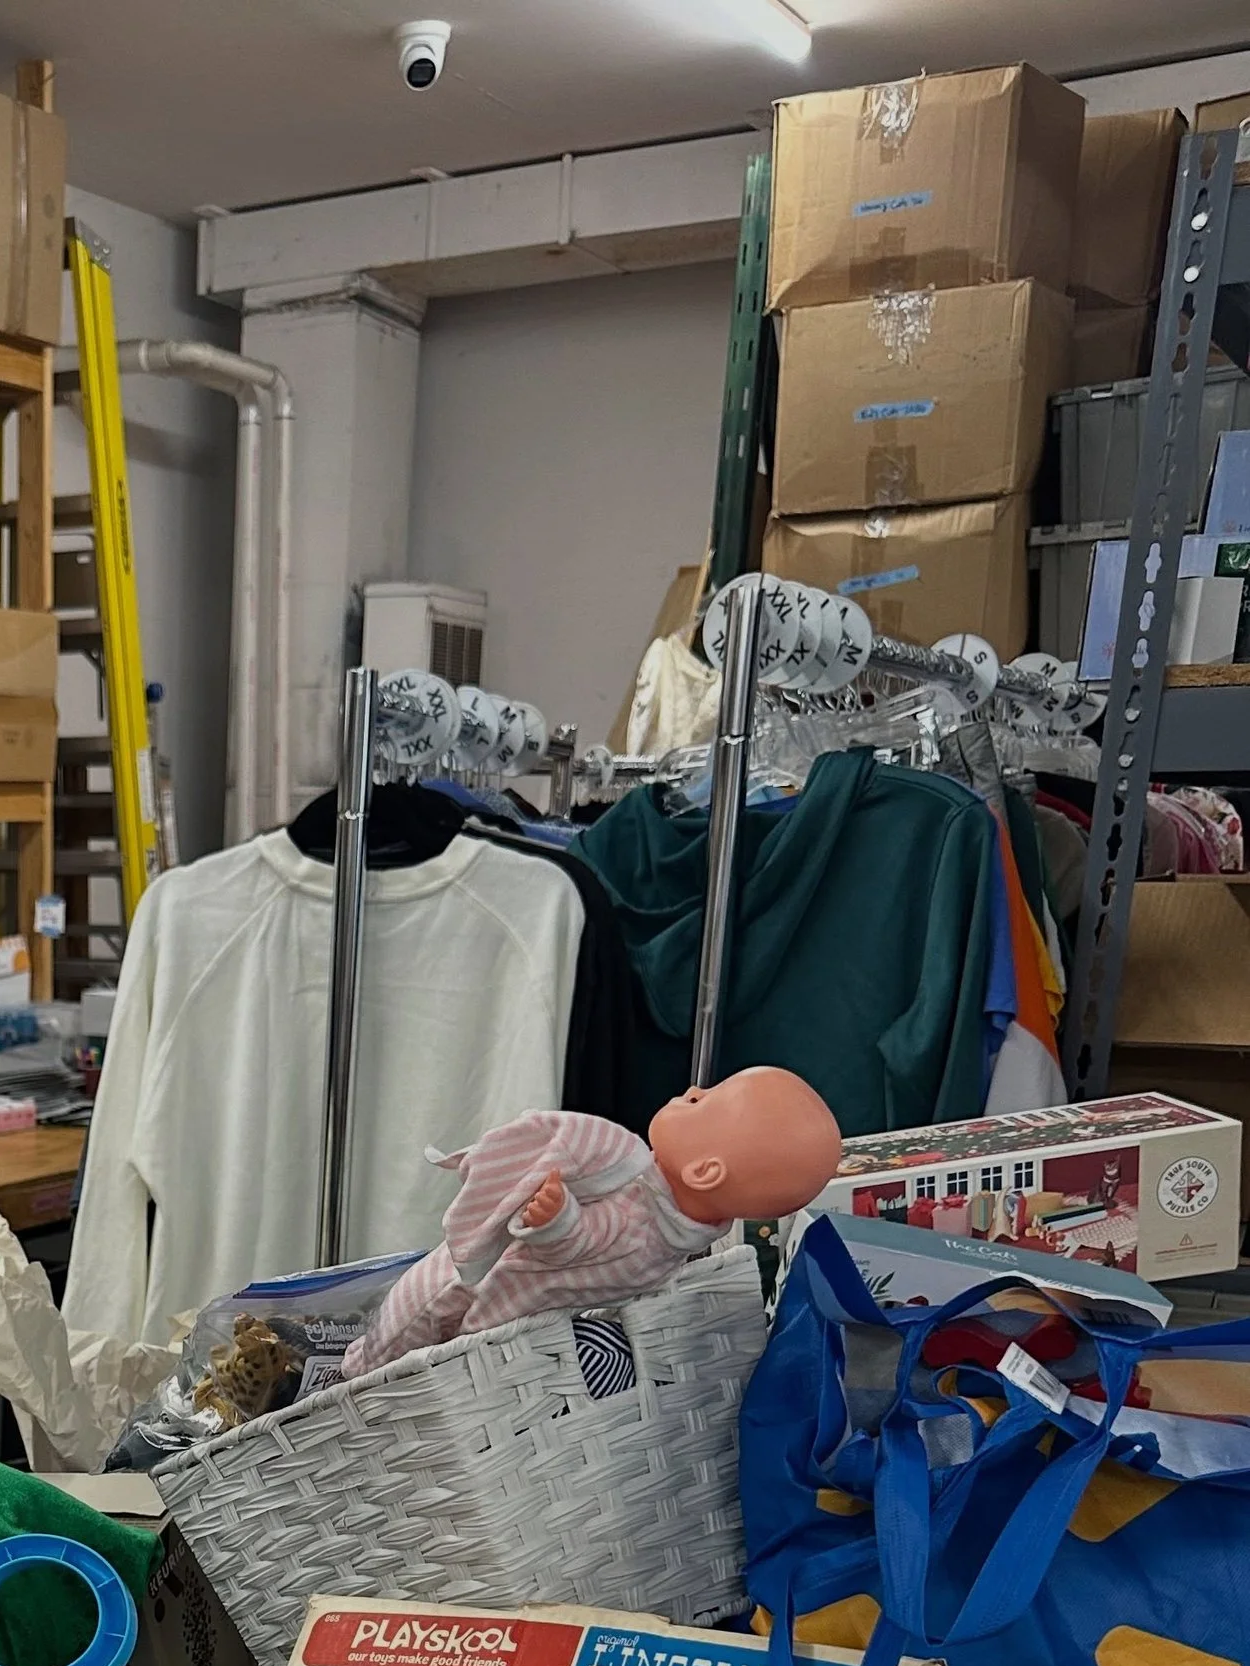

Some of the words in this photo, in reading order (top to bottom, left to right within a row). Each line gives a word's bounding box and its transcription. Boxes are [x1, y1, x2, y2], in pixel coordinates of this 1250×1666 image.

[768, 585, 793, 624] XXL
[974, 651, 987, 665] S
[427, 688, 447, 723] XXL
[966, 690, 979, 704] S
[403, 735, 433, 758] XXL
[1165, 1164, 1184, 1181] TRUE
[1186, 1161, 1212, 1177] SOUTH
[1166, 1200, 1195, 1214] PUZZLE
[942, 1239, 975, 1253] The
[149, 1540, 186, 1597] KEURIG
[350, 1619, 518, 1656] PLAYSKOOL
[597, 1634, 640, 1652] original
[348, 1651, 367, 1663] our
[368, 1652, 396, 1666] toys
[397, 1653, 429, 1666] make
